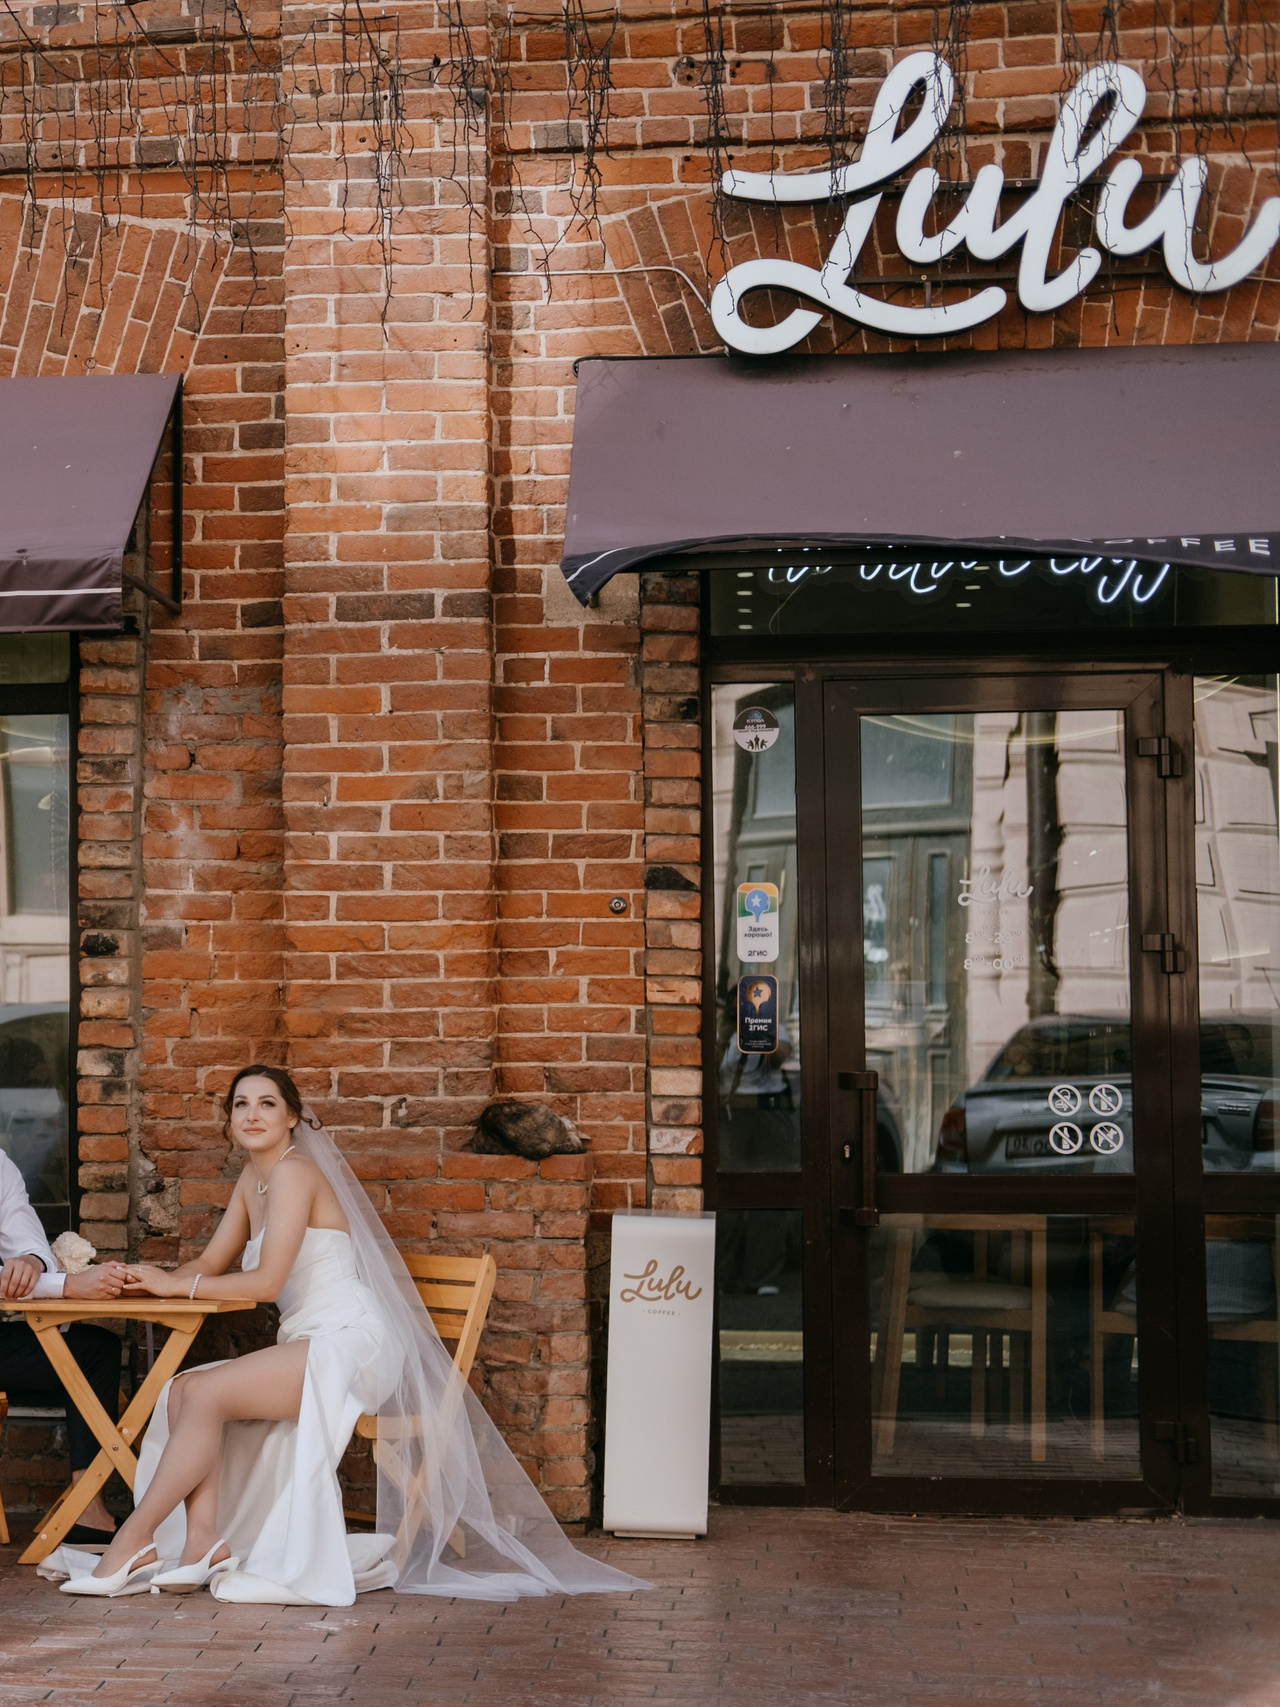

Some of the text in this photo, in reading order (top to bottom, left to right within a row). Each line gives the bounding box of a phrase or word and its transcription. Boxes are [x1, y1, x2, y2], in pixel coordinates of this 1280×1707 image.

[712, 52, 1280, 354] Lulu
[620, 1259, 703, 1302] Lulu
[647, 1308, 675, 1316] COFFEE
